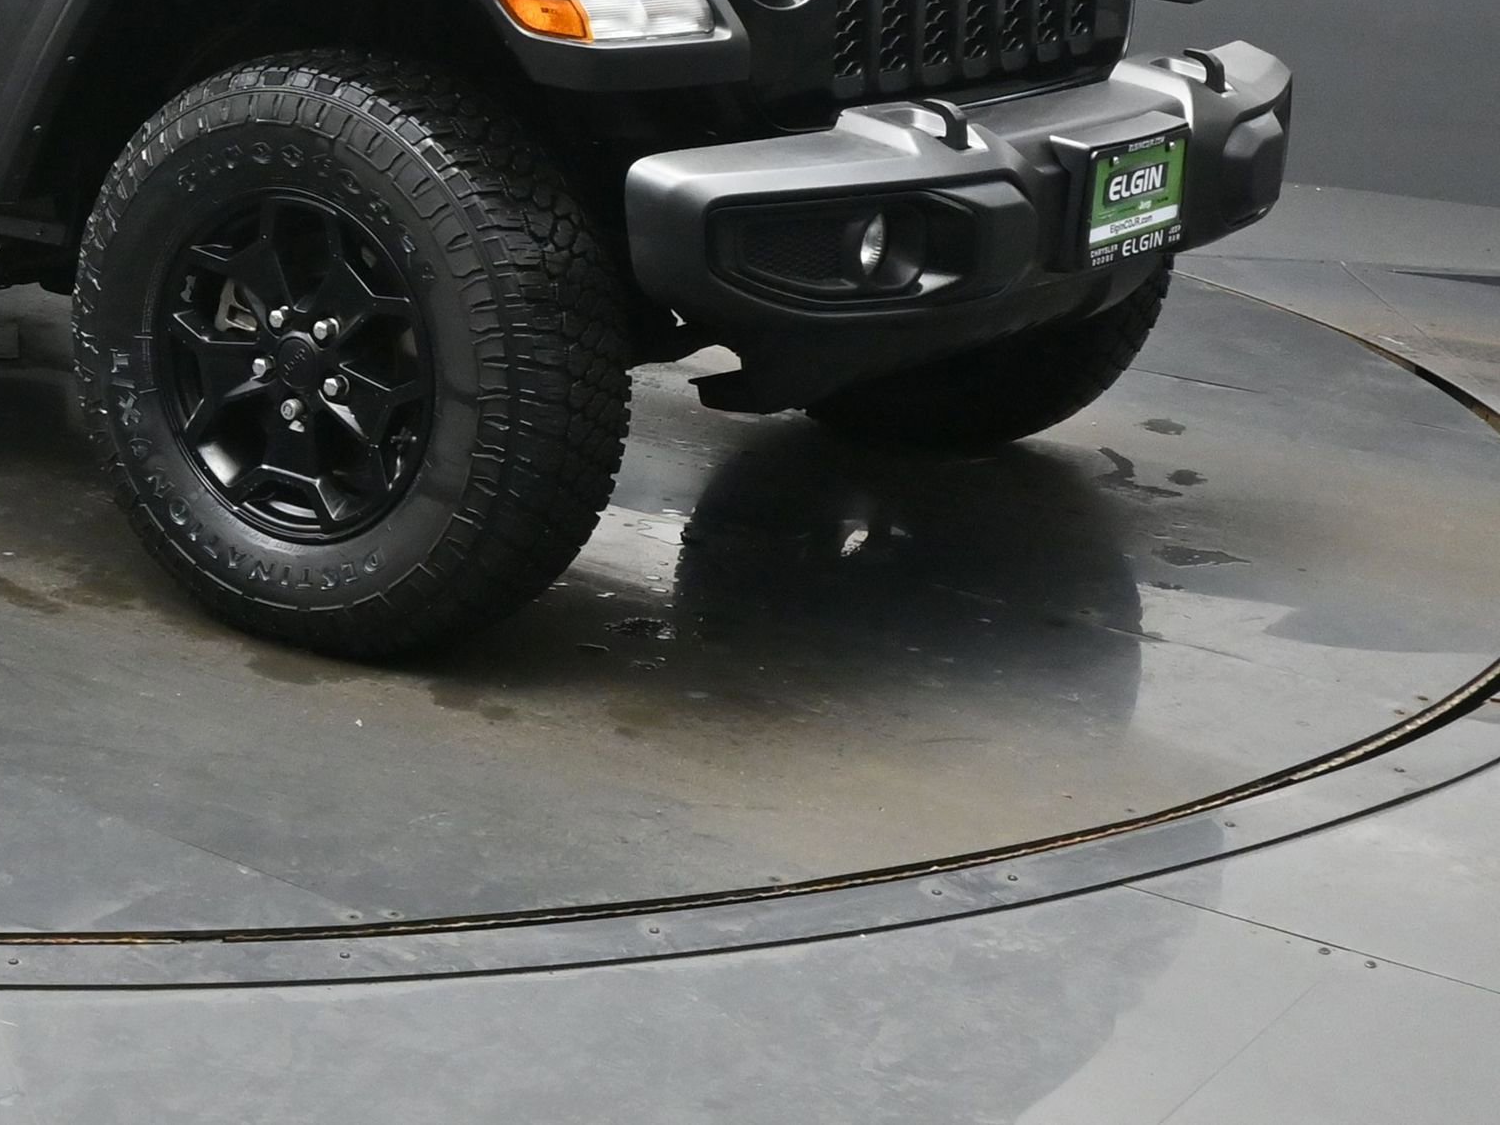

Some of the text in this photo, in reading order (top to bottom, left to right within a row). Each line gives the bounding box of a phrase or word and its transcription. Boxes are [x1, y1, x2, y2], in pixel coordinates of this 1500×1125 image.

[1109, 164, 1163, 201] ELGIN
[1090, 244, 1118, 258] CHRYSLER
[1122, 230, 1163, 256] ELGIN
